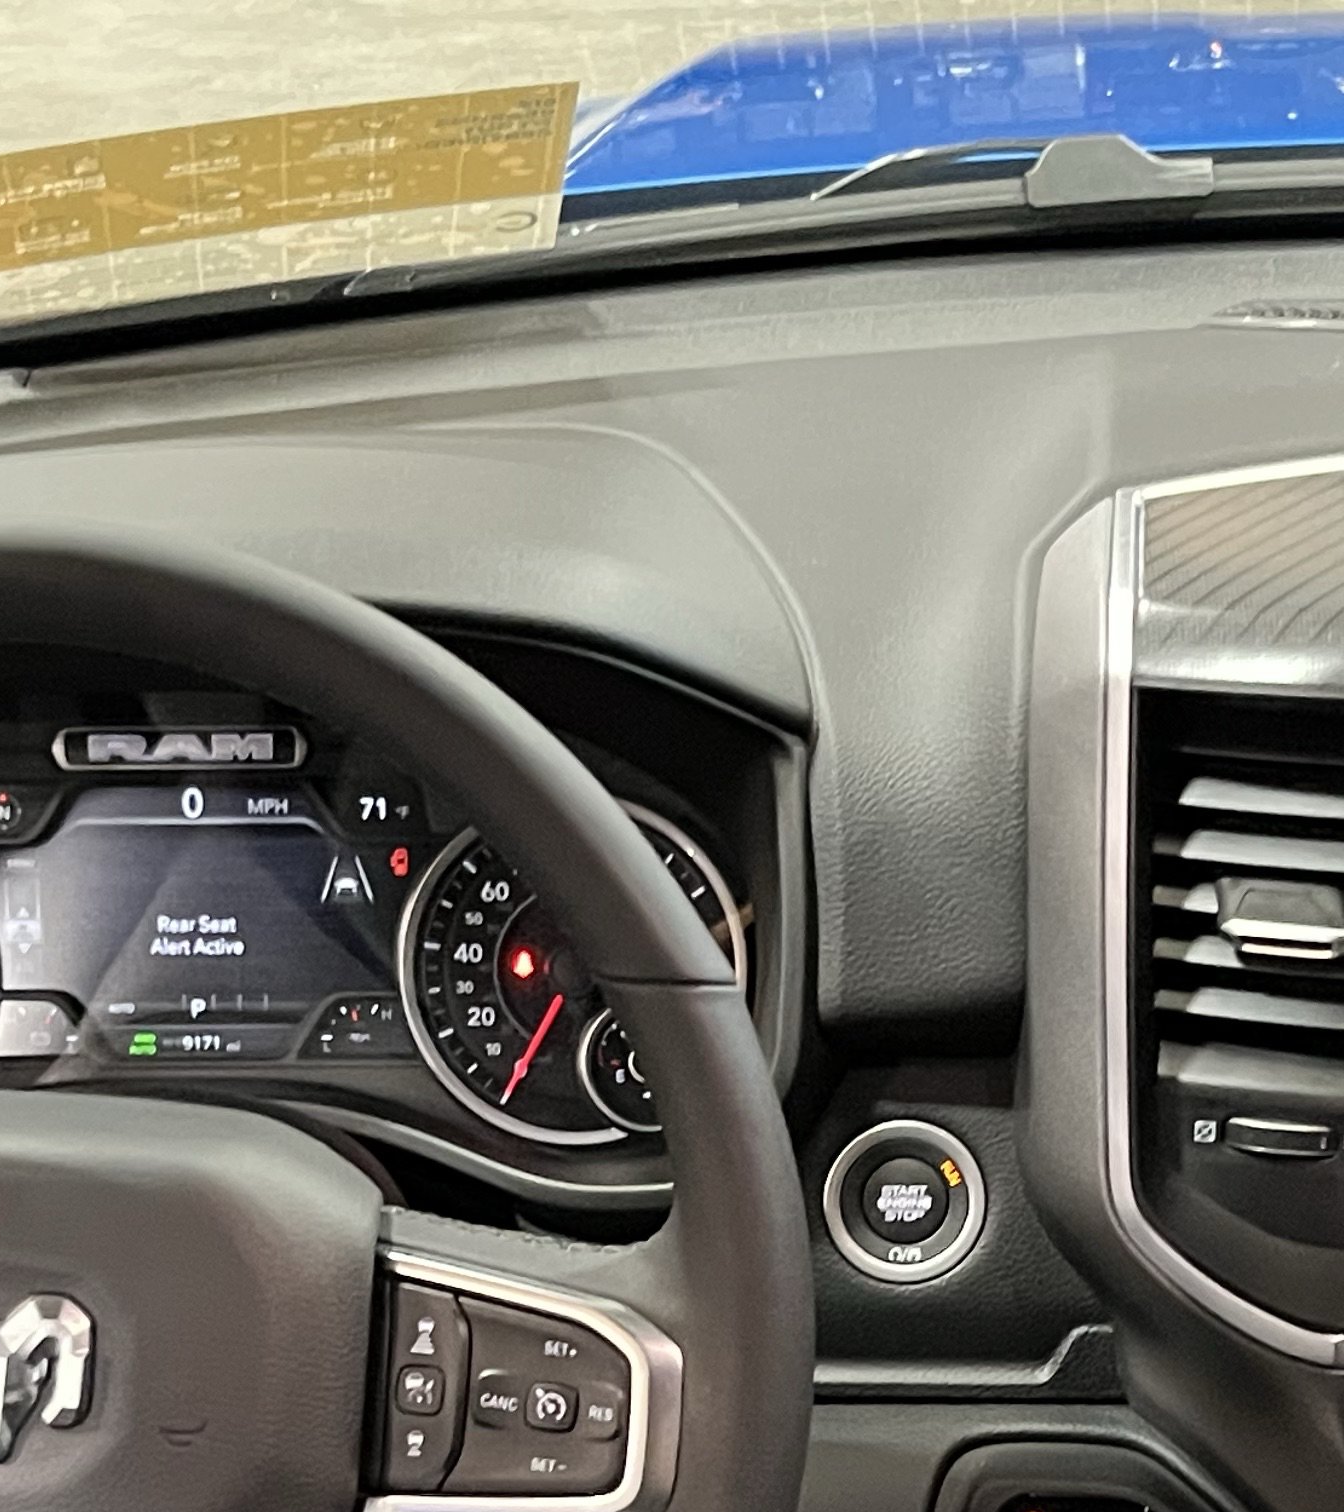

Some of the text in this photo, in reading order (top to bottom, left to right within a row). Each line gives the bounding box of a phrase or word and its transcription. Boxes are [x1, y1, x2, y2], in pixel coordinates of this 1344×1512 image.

[87, 734, 274, 762] RAM
[181, 786, 288, 819] 0 MPH
[359, 797, 387, 821] 71
[481, 881, 510, 902] 60
[157, 914, 237, 933] Rear Seat
[465, 912, 483, 926] 50
[150, 937, 245, 955] Alert Active
[454, 944, 483, 963] 40
[456, 981, 474, 994] 30
[191, 998, 206, 1019] P
[467, 1007, 495, 1027] 20
[486, 1043, 501, 1057] 10
[480, 1393, 518, 1412] CANC
